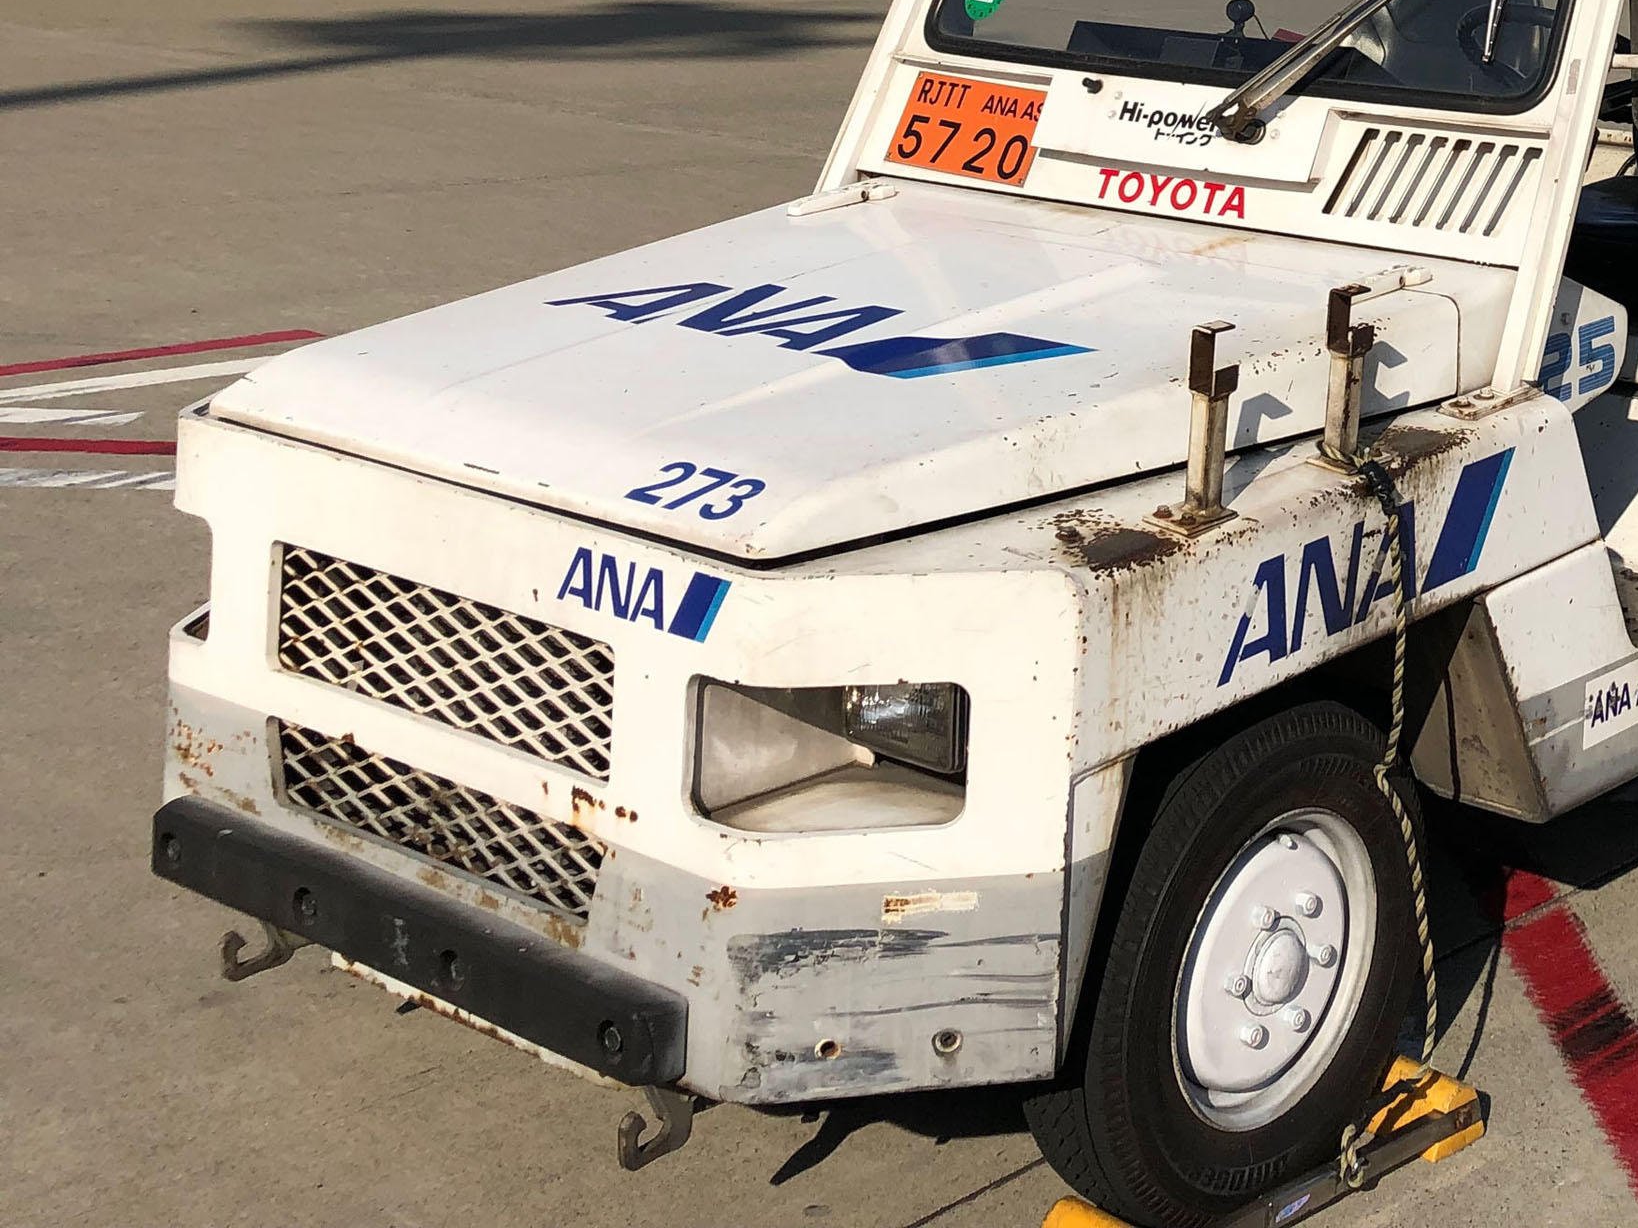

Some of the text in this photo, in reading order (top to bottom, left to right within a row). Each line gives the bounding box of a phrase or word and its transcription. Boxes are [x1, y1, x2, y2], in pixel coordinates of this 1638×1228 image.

[917, 78, 972, 109] RJTT
[981, 95, 1018, 118] ANA
[1119, 100, 1217, 133] Hi-power
[1098, 168, 1245, 220] TOYOTA
[544, 282, 905, 352] ANA
[624, 461, 767, 520] 273
[556, 546, 665, 631] ANA
[1217, 499, 1417, 688] ANA
[1591, 683, 1631, 729] ANA
